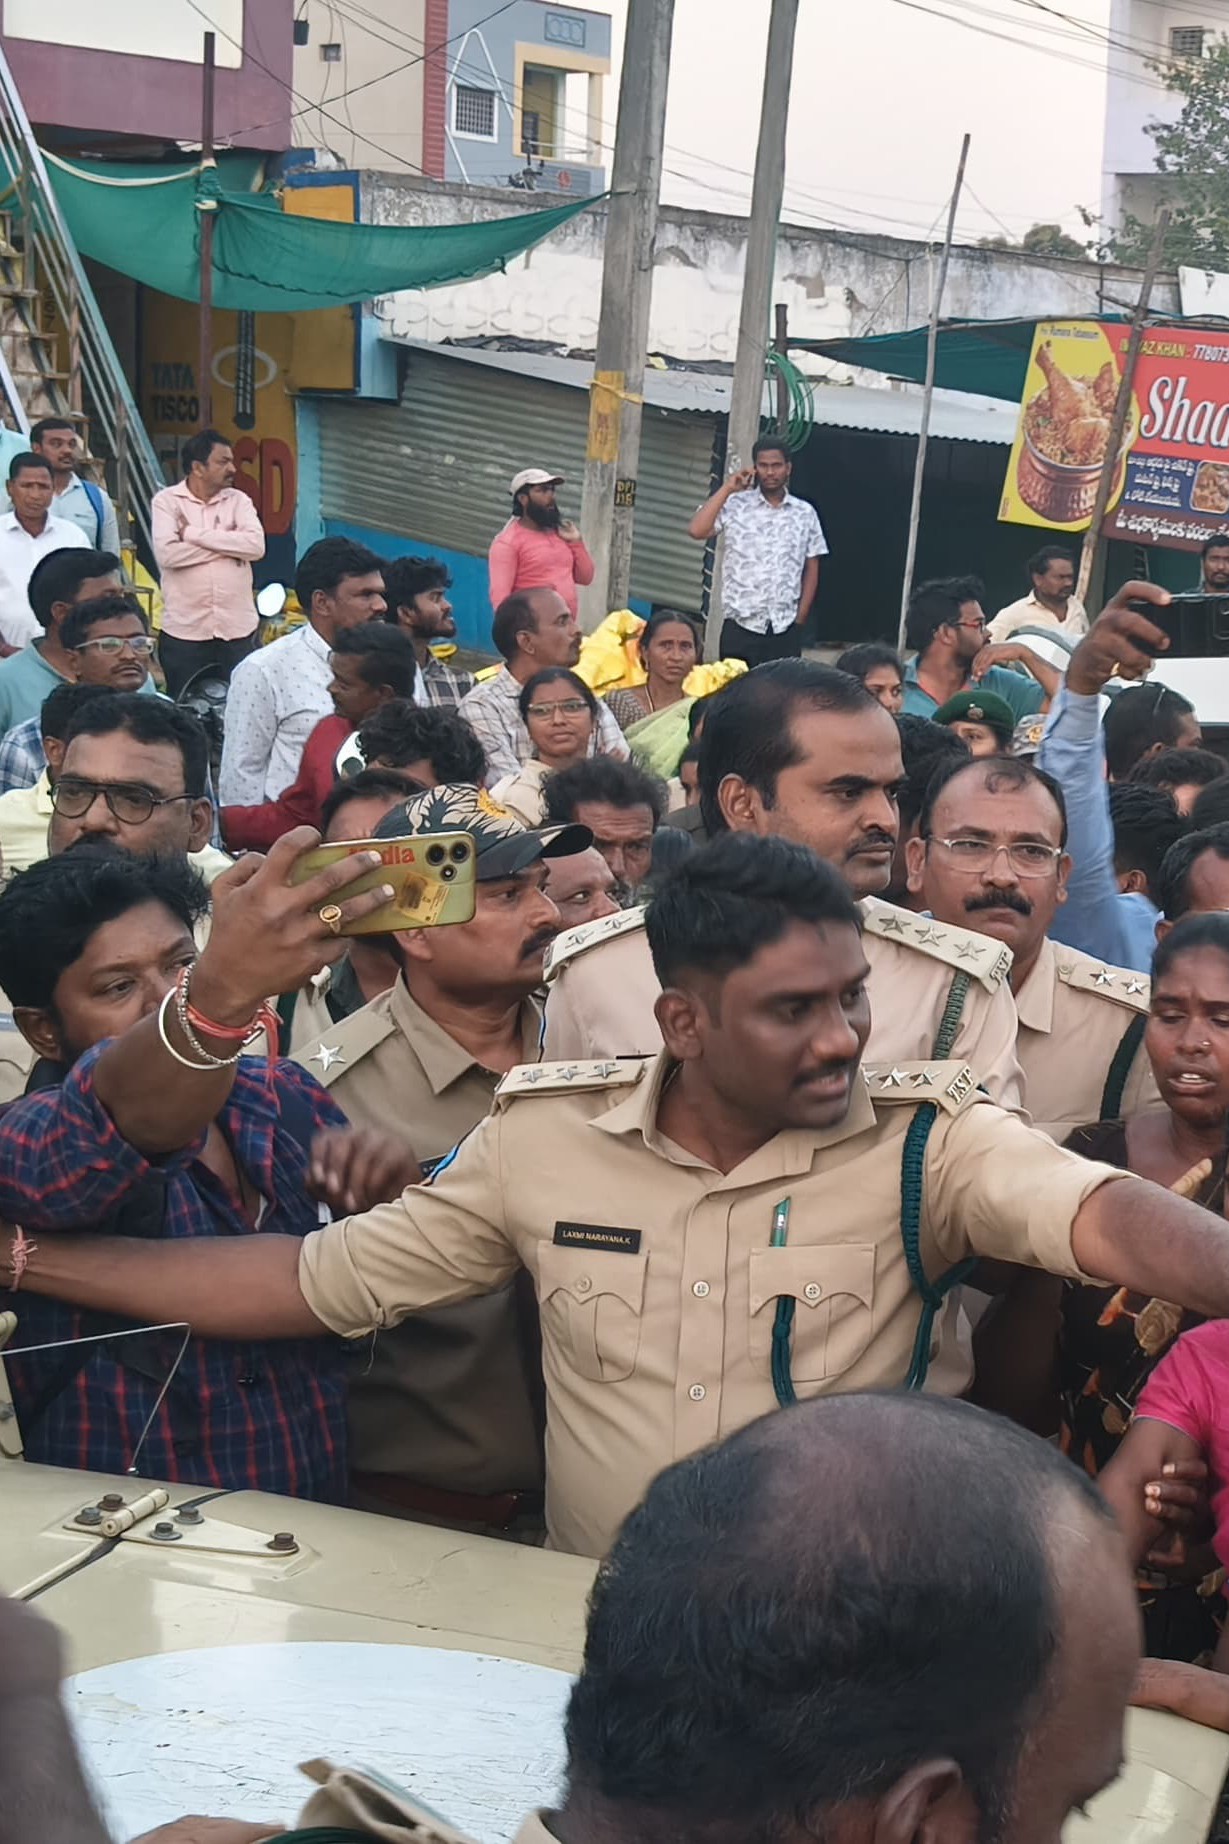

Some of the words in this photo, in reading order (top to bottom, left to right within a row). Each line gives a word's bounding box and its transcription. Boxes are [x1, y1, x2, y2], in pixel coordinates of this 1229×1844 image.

[153, 363, 195, 391] TATA
[153, 394, 213, 425] TISCO
[562, 1230, 585, 1240] LAXMI
